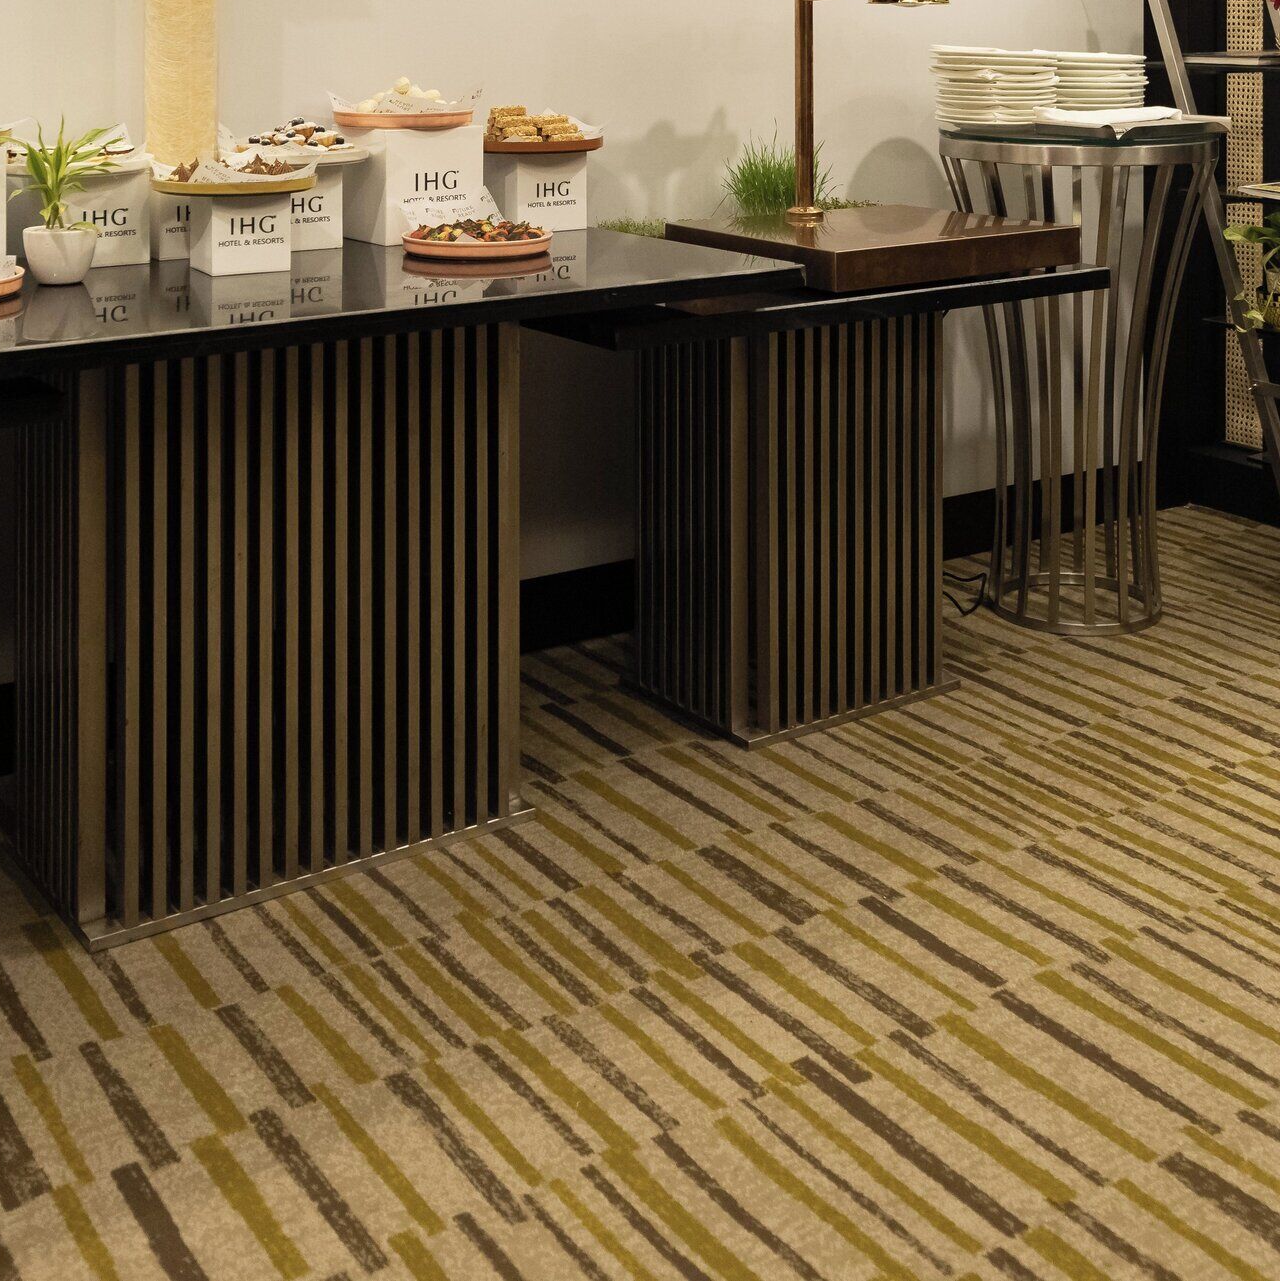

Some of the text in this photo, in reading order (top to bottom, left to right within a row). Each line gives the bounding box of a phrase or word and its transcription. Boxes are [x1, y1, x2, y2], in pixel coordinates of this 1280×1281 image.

[415, 170, 460, 192] IHG
[536, 180, 571, 198] IHG
[436, 193, 467, 202] RESORTS
[552, 199, 577, 207] RESORTS
[302, 216, 331, 224] RESORTS
[230, 215, 277, 235] IHG
[104, 229, 137, 238] RESORTS
[243, 238, 251, 246] &
[252, 237, 285, 245] RESORTS
